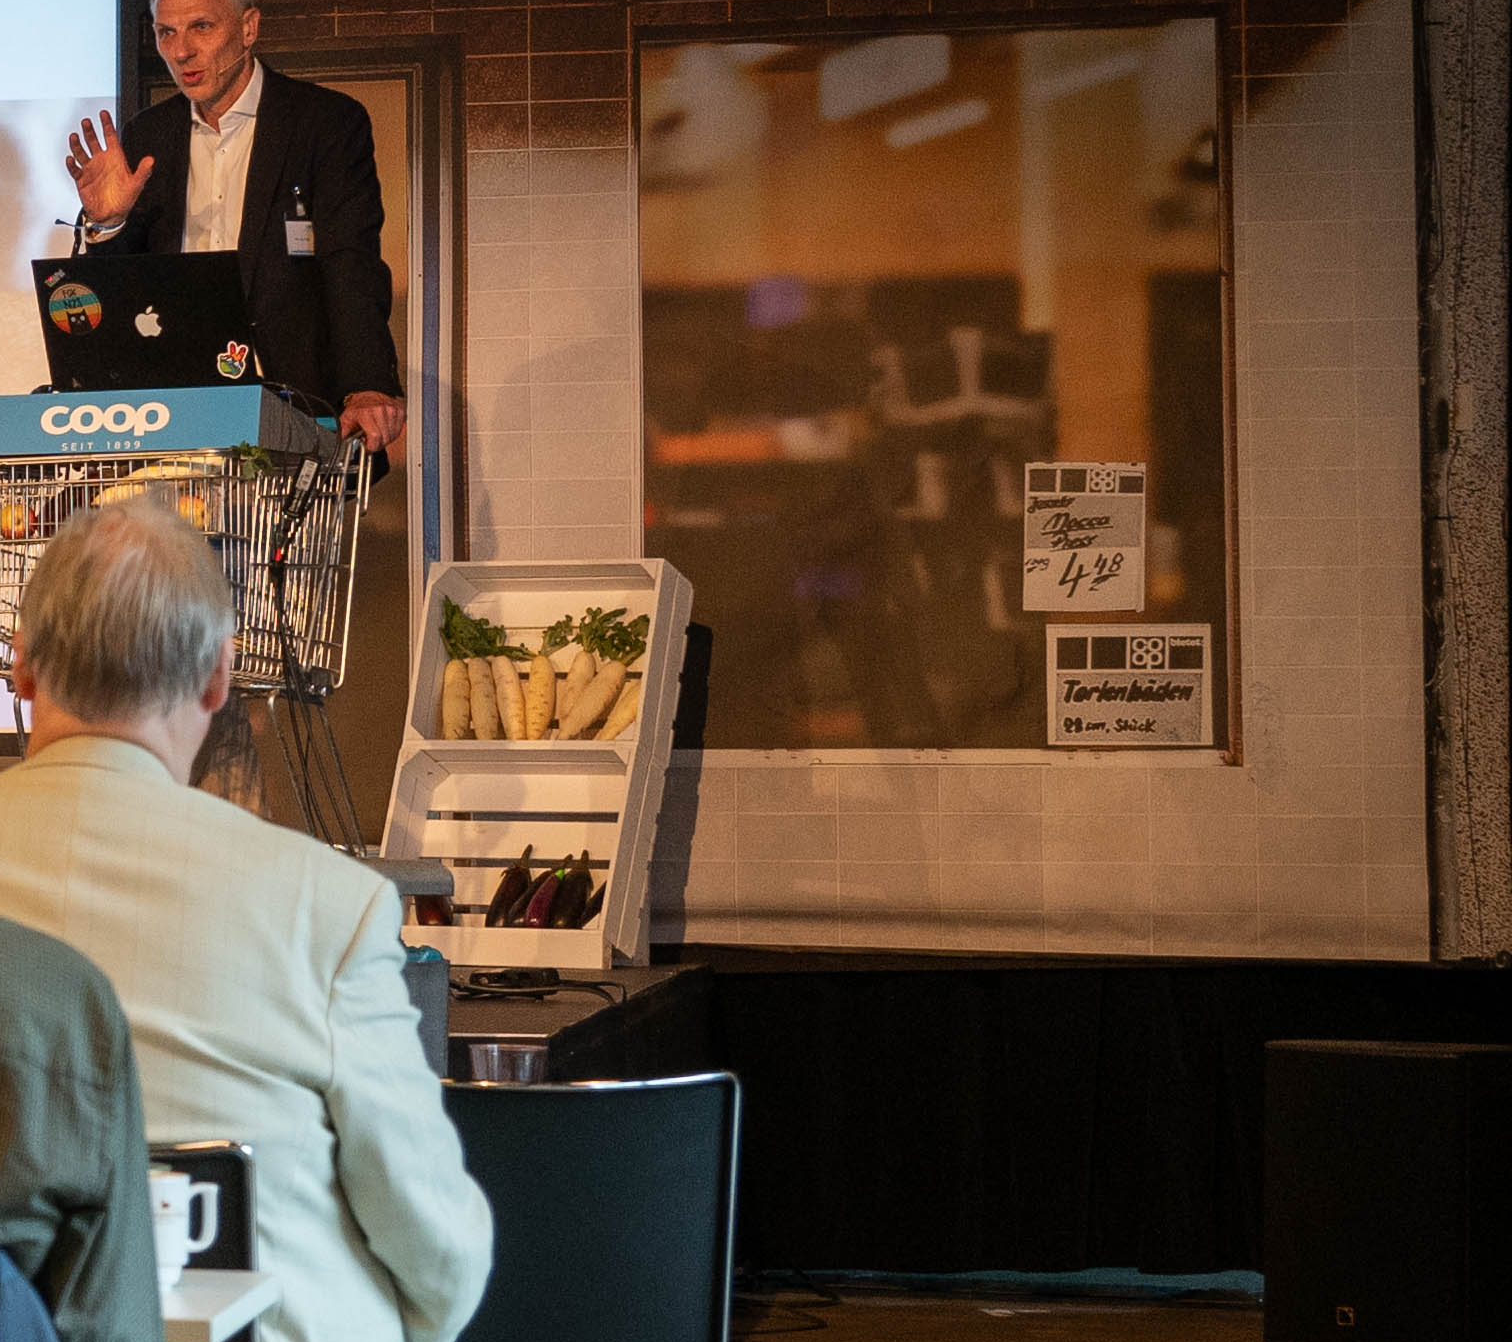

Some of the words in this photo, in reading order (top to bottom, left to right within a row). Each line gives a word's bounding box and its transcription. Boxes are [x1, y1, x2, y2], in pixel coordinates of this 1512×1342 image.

[40, 402, 170, 437] coop
[61, 441, 94, 452] SEIT
[106, 439, 142, 451] 1899
